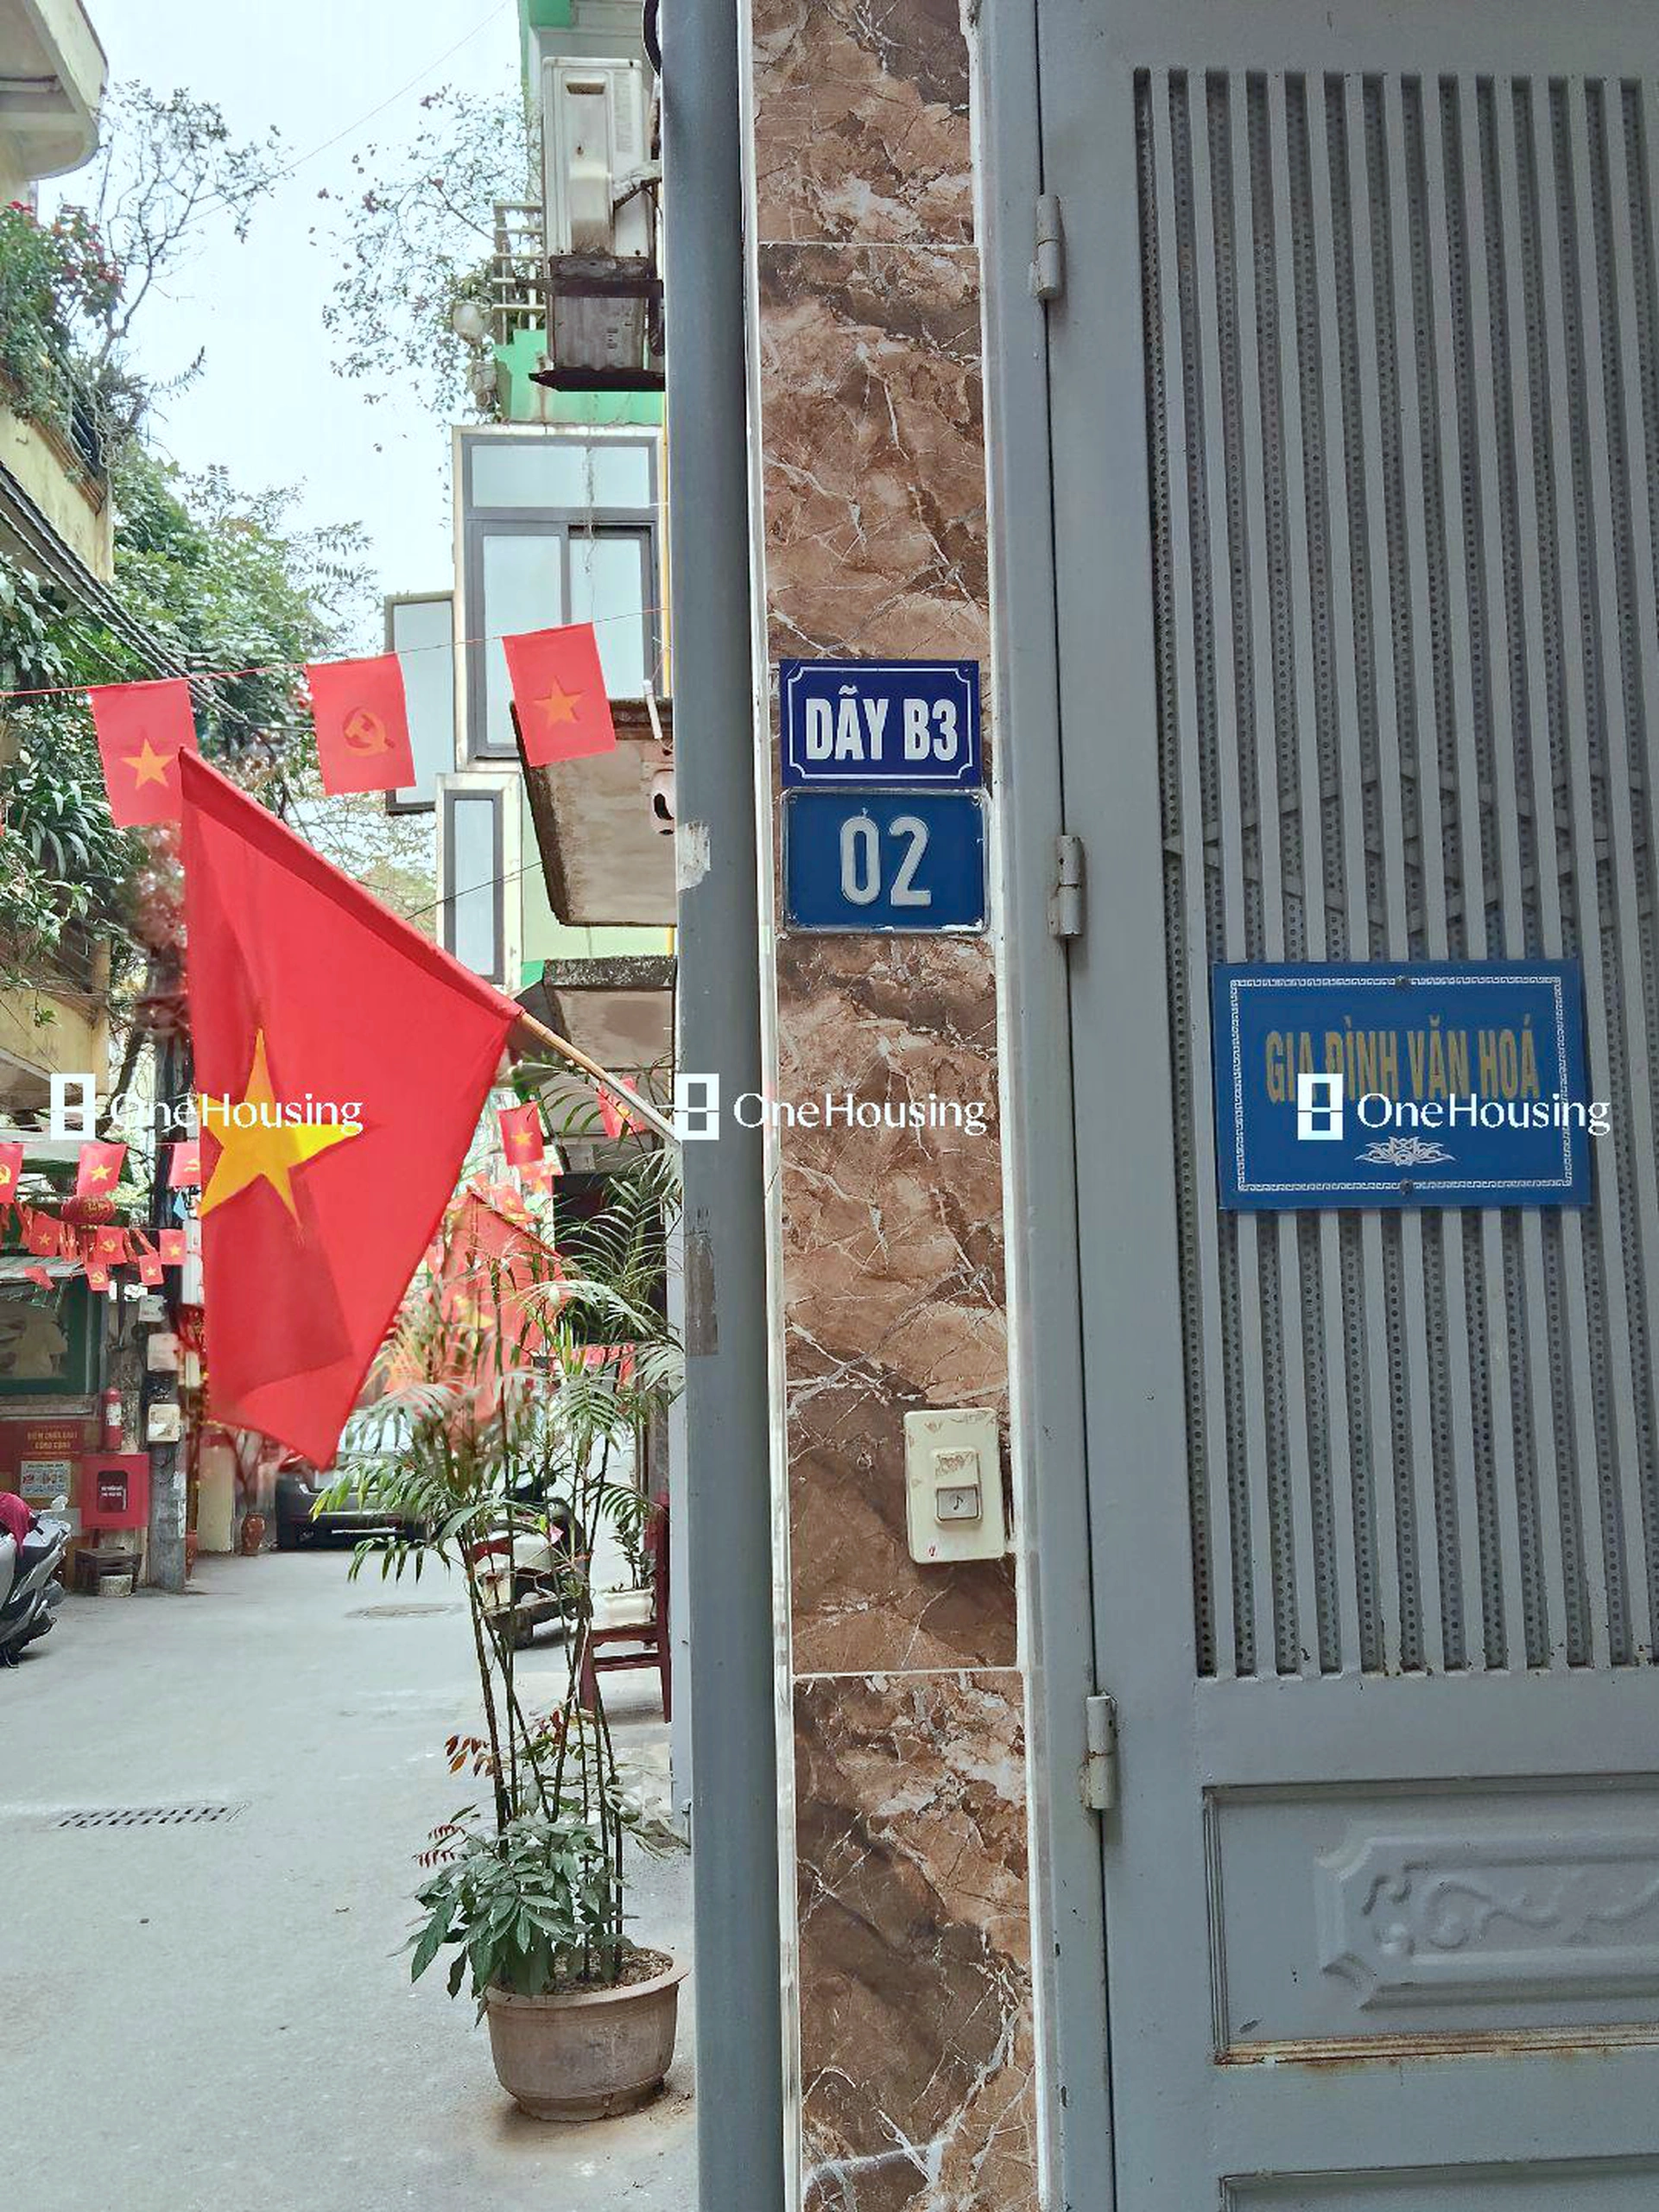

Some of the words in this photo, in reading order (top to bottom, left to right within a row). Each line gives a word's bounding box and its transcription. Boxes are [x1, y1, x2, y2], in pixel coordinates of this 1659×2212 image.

[805, 684, 889, 760] DÃY
[903, 698, 959, 761] B3
[839, 814, 932, 907] 02
[1265, 1030, 1315, 1104] GIA
[1325, 1014, 1400, 1103] ĐÌNH
[1407, 1014, 1468, 1102] VĂN
[1478, 1014, 1540, 1100] HOÁ
